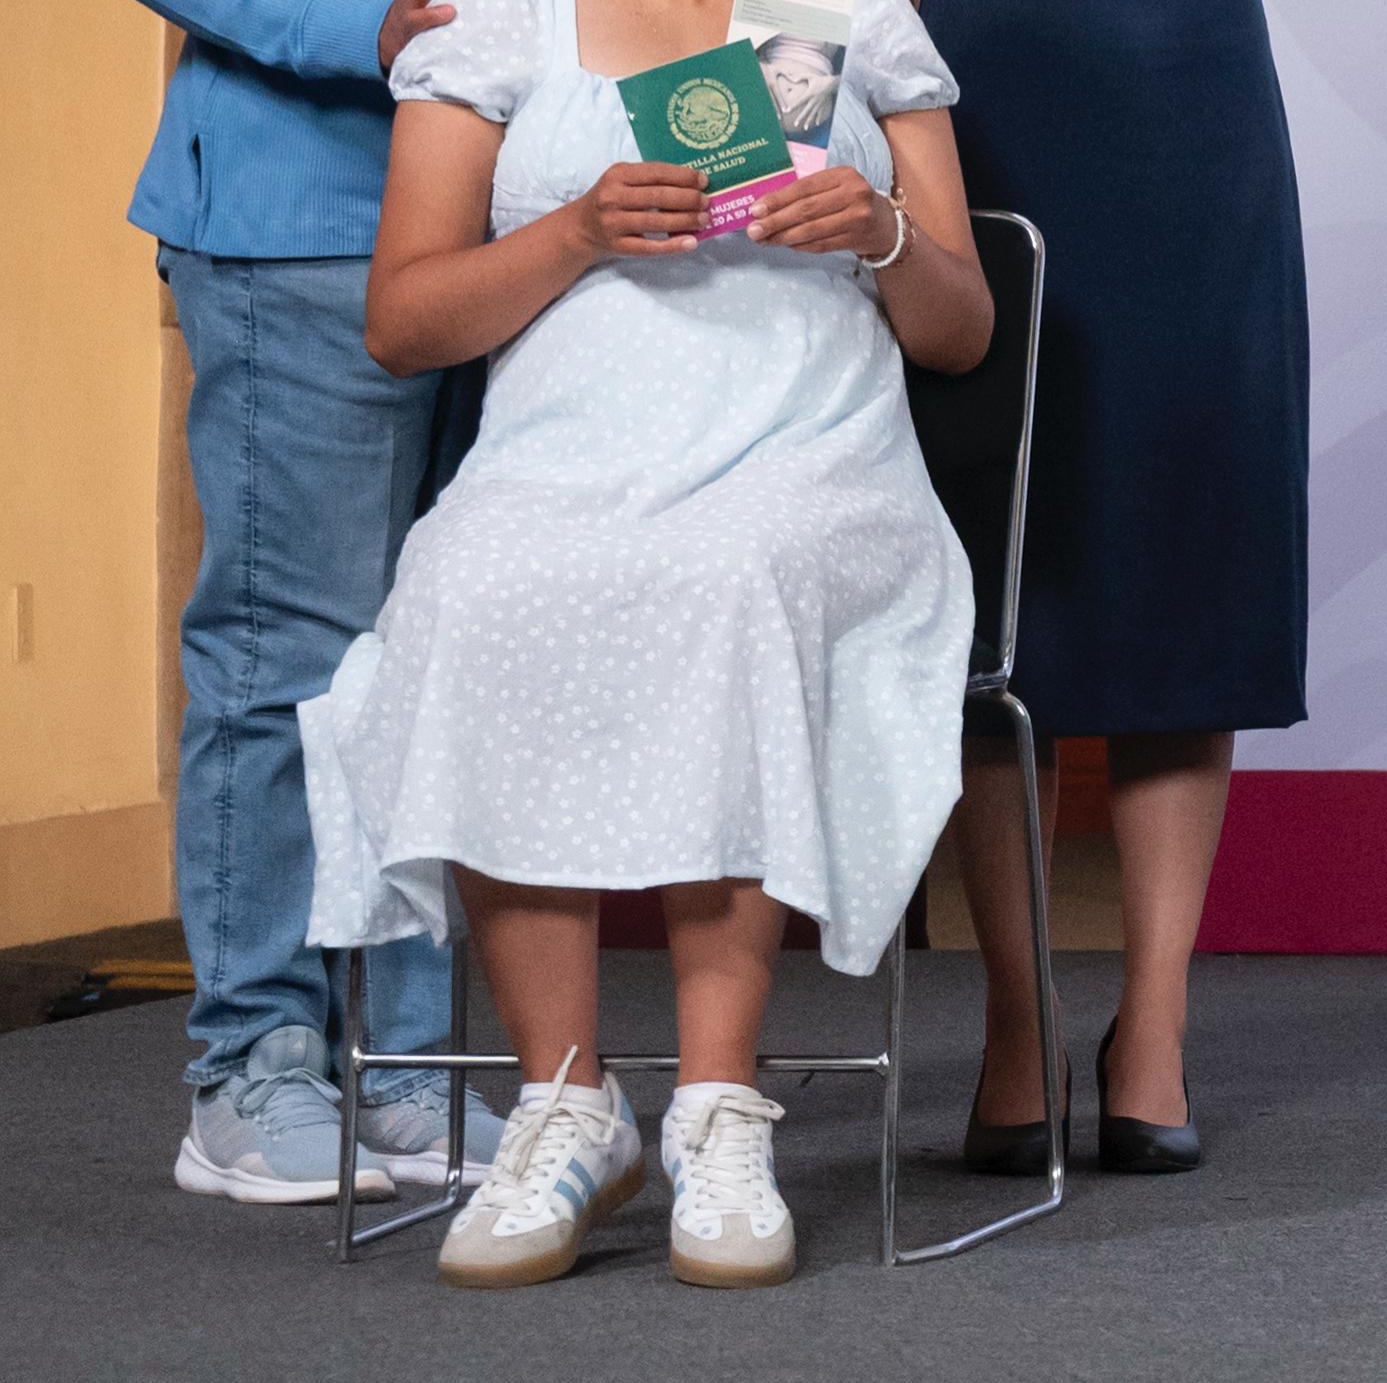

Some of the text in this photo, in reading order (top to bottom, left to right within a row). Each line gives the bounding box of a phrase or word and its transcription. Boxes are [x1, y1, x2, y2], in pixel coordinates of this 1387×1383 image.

[718, 137, 769, 159] NACIONAL
[713, 156, 746, 172] SALUD
[710, 195, 755, 215] MUJERES
[726, 214, 734, 223] A
